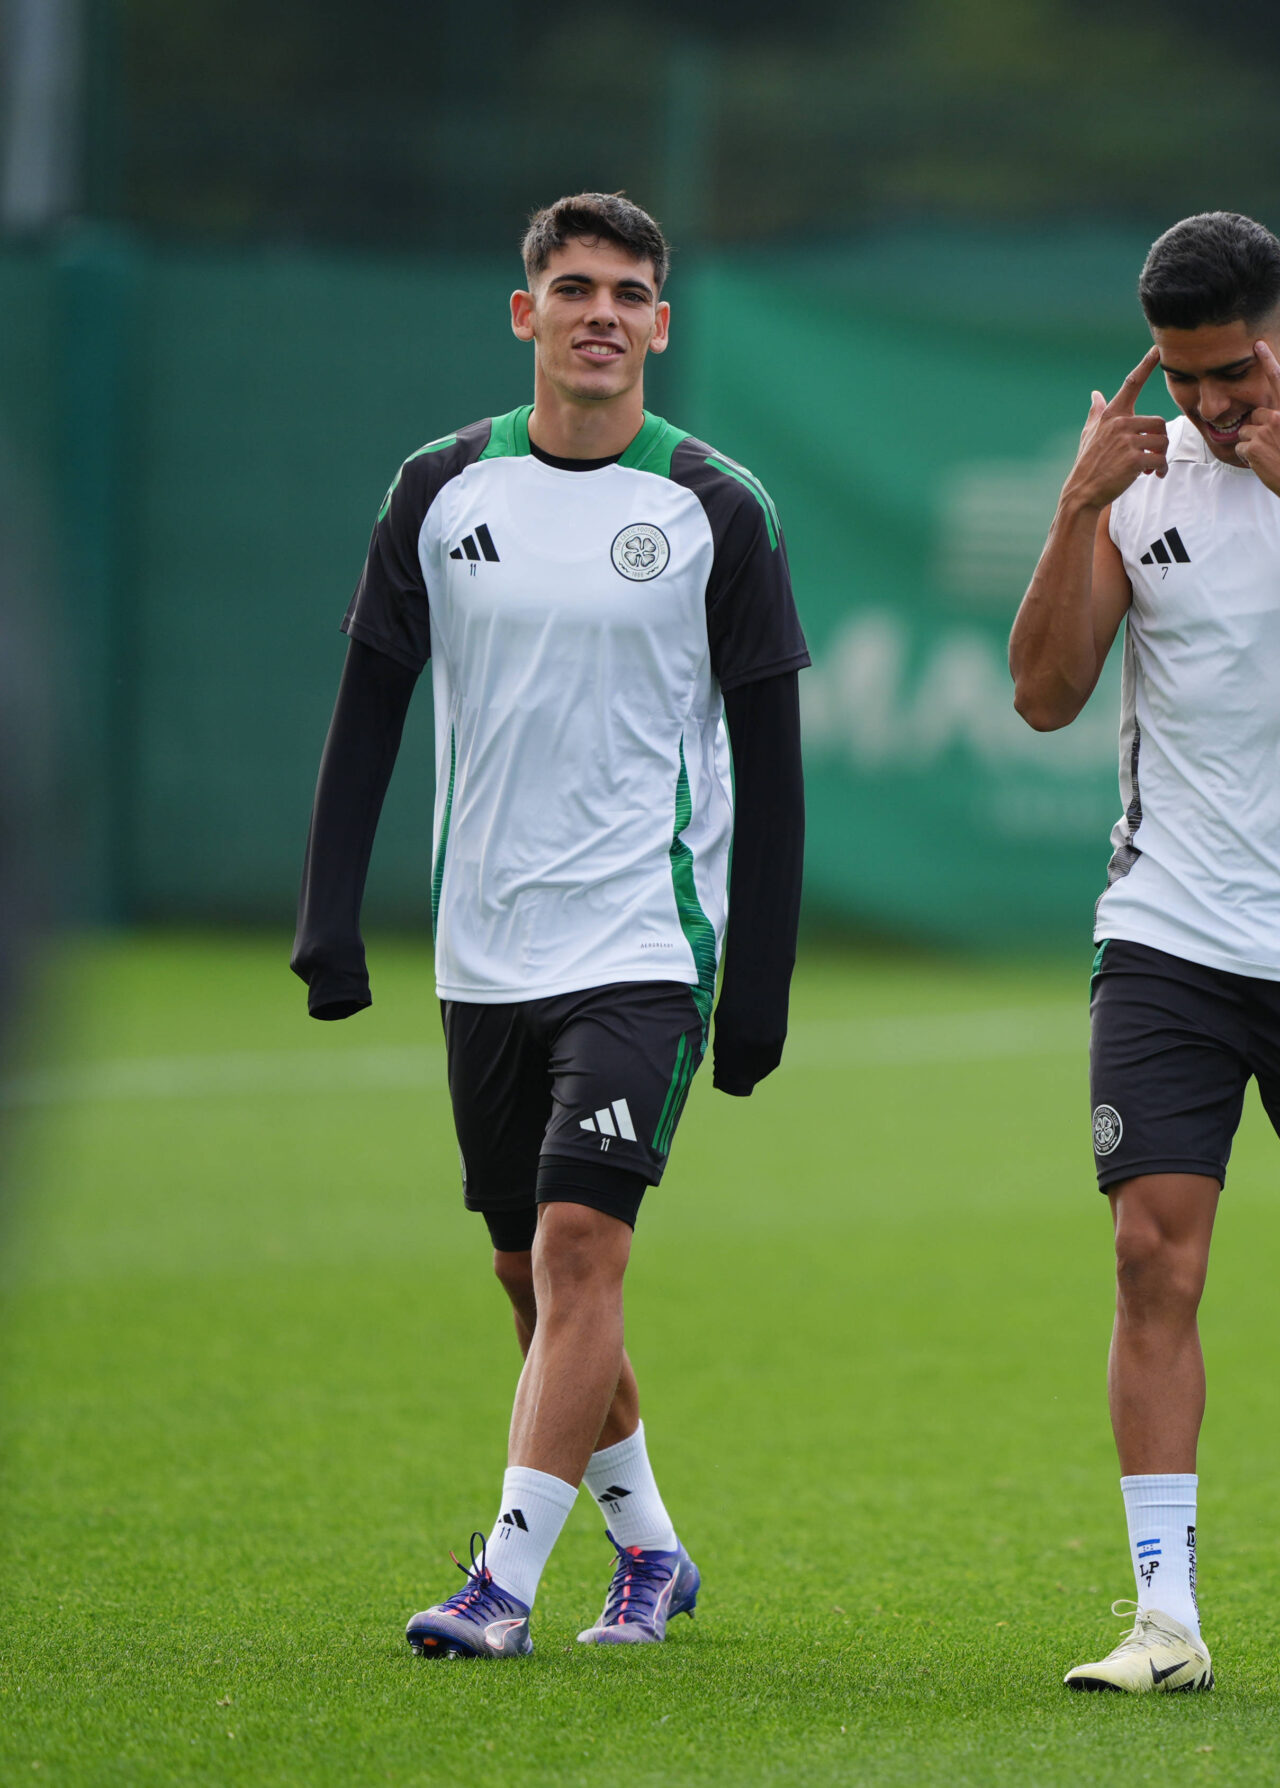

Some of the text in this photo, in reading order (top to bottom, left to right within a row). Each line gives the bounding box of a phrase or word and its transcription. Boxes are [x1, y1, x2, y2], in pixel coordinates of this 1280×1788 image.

[470, 563, 477, 577] 11
[1161, 566, 1169, 580] 7
[600, 1137, 611, 1152] 11
[609, 1501, 622, 1514] 11
[499, 1526, 511, 1540] 11
[1139, 1560, 1159, 1578] LP
[1145, 1575, 1152, 1588] 7
